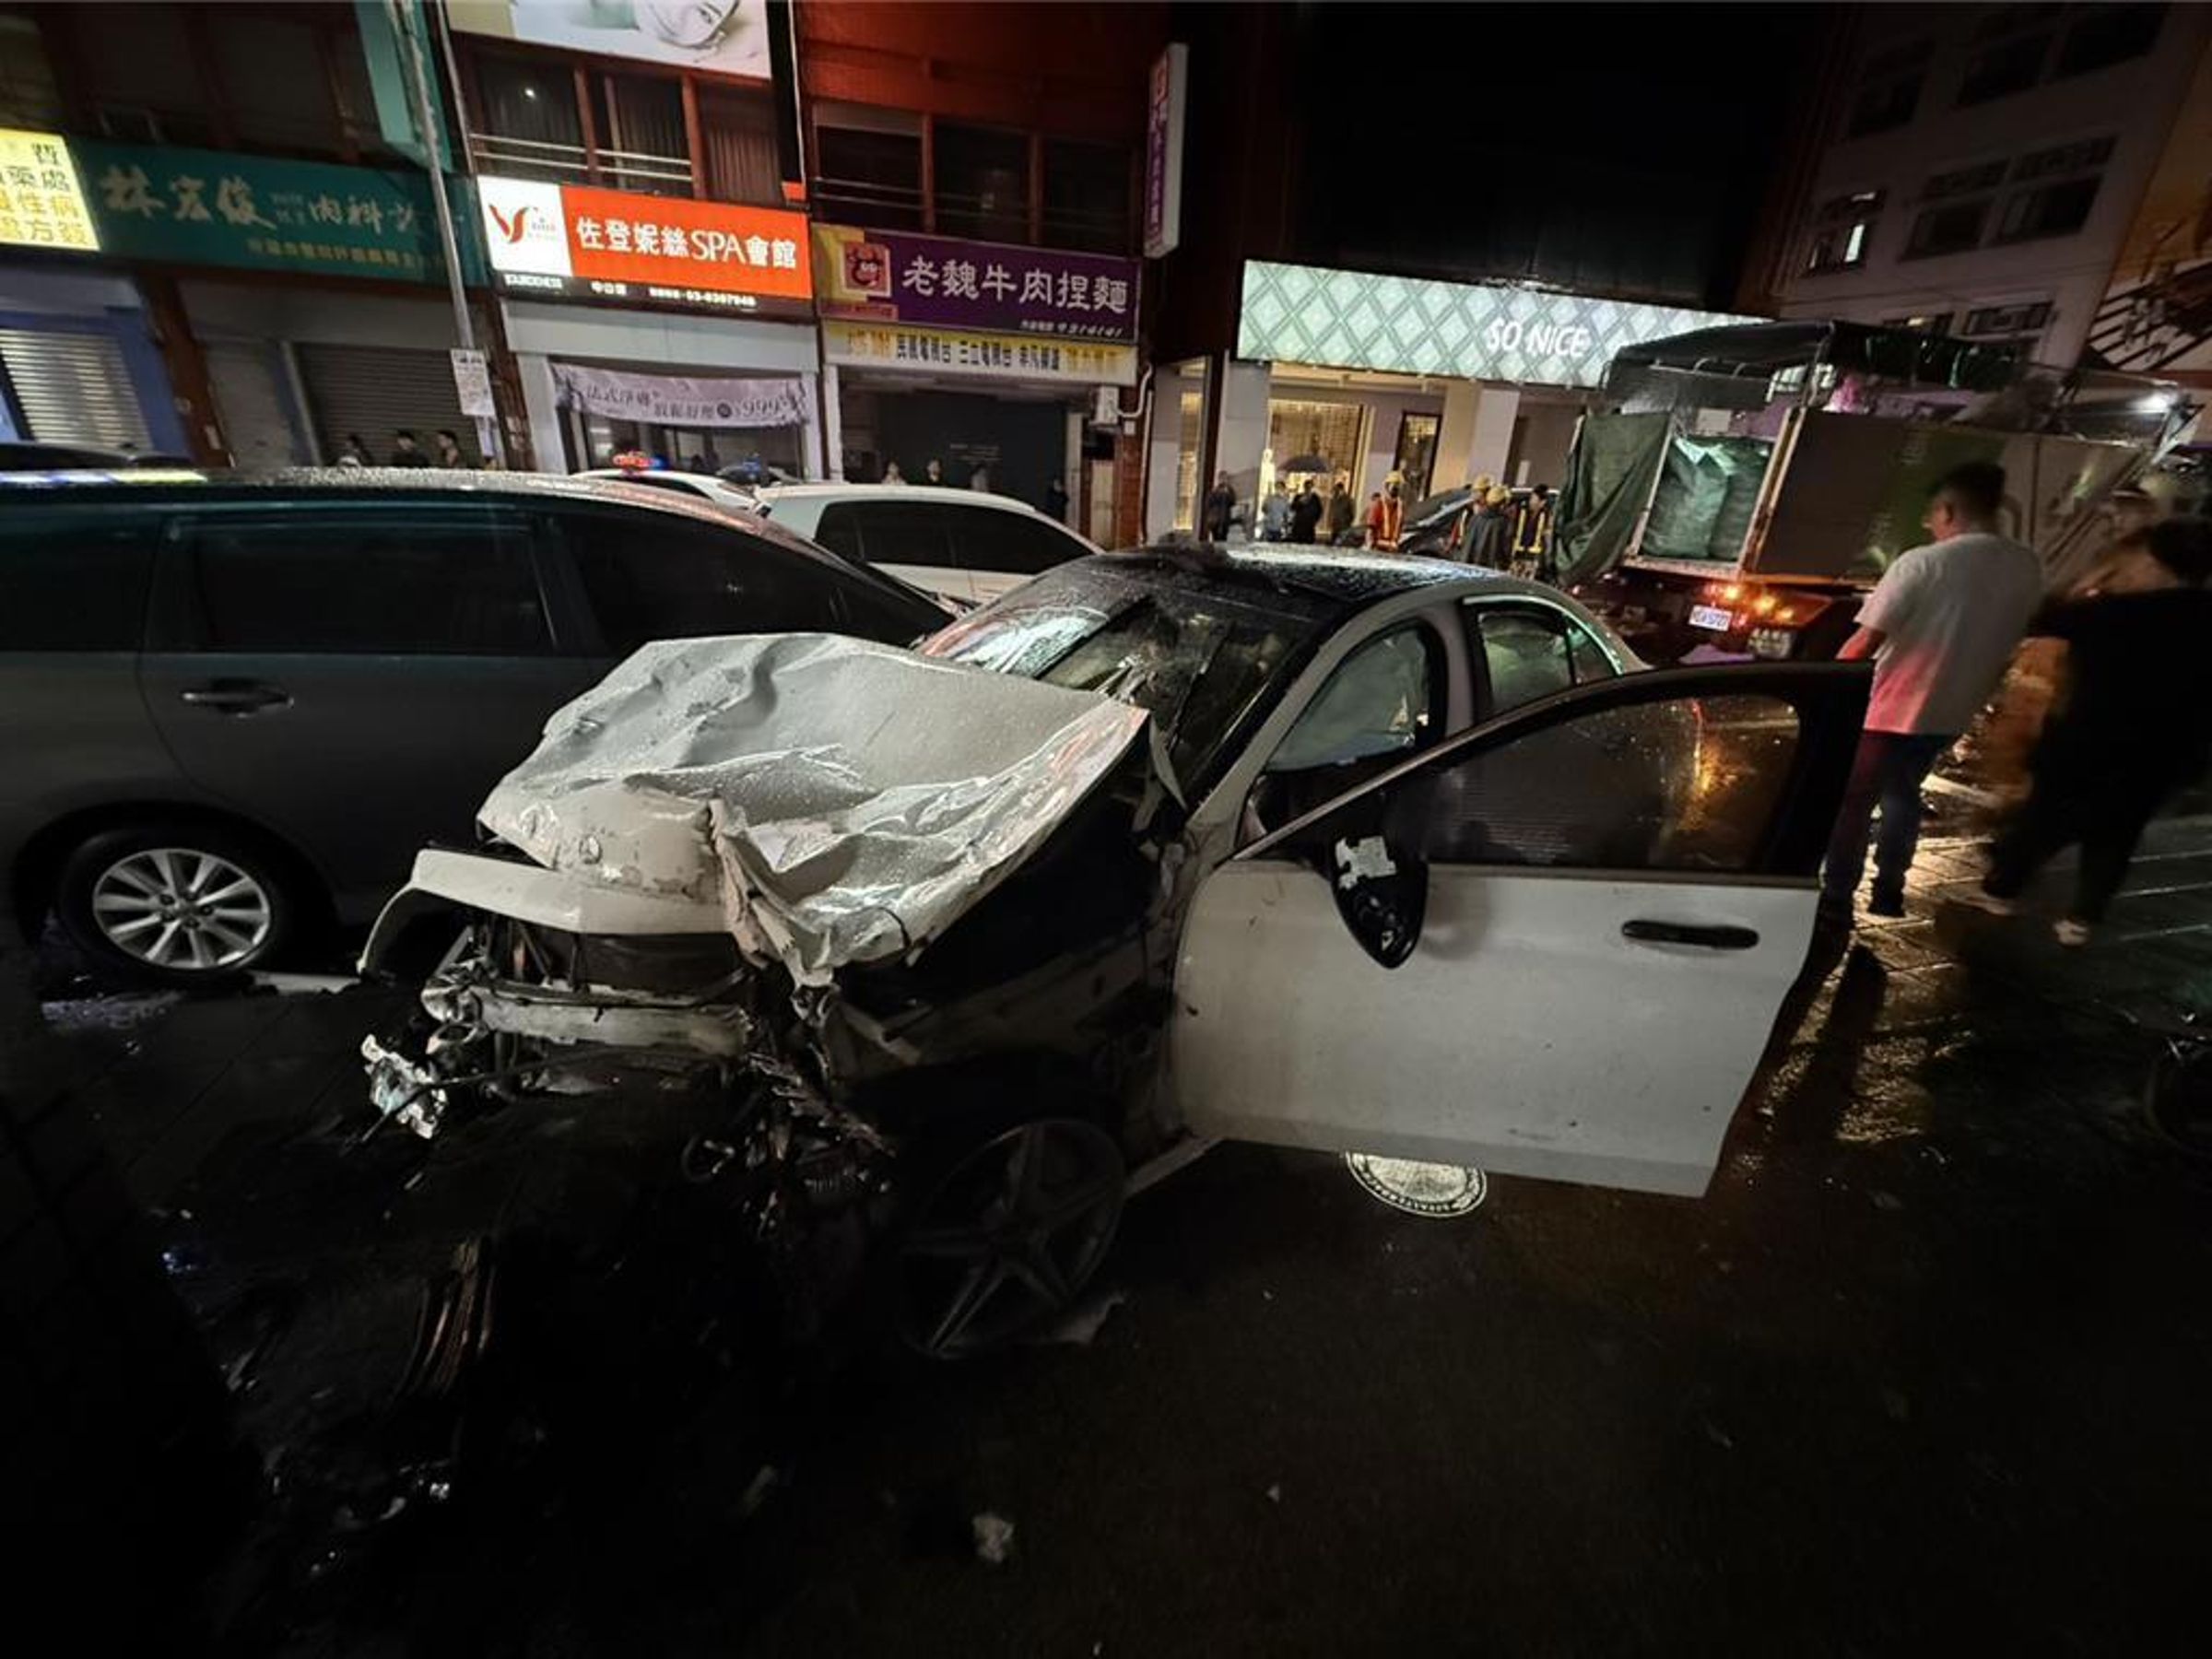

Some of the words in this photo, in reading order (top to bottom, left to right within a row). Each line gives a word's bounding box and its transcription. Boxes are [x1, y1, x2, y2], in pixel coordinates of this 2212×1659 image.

[577, 217, 796, 268] 佐登妮絲SPA會館
[902, 254, 1127, 314] 老魏牛肉捏麵
[1487, 317, 1523, 351] SO
[1526, 324, 1589, 358] NICE
